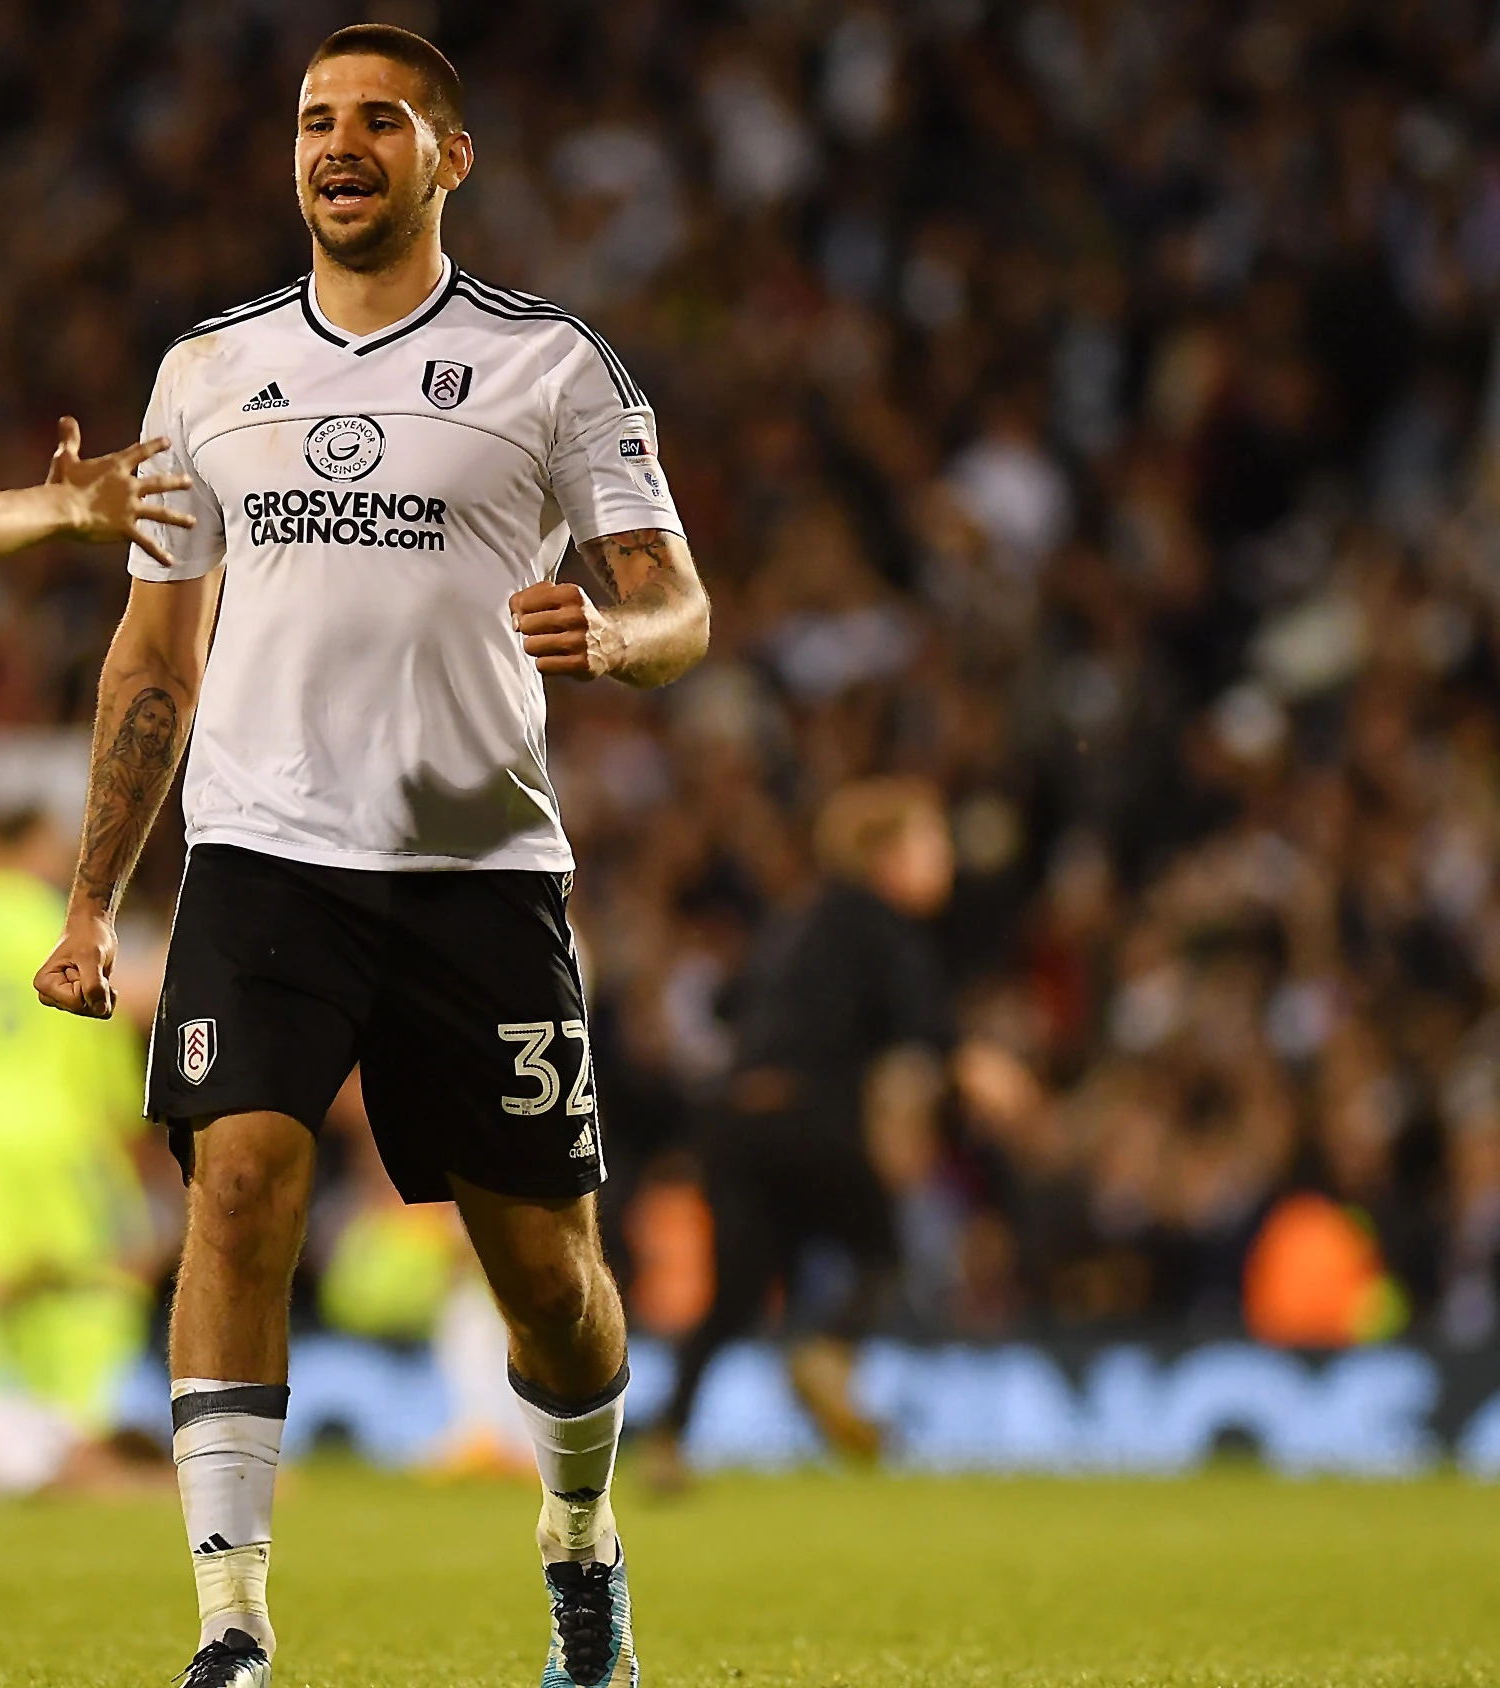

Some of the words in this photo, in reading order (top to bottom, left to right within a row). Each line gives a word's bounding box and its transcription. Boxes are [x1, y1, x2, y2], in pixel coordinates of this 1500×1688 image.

[242, 399, 290, 412] adidas
[314, 420, 376, 443] GROSVENOR
[621, 440, 640, 455] sky
[319, 457, 368, 474] CASINOS
[243, 489, 447, 525] GROSVENOR
[251, 517, 445, 552] CASINOS.com
[497, 1019, 594, 1116] 32
